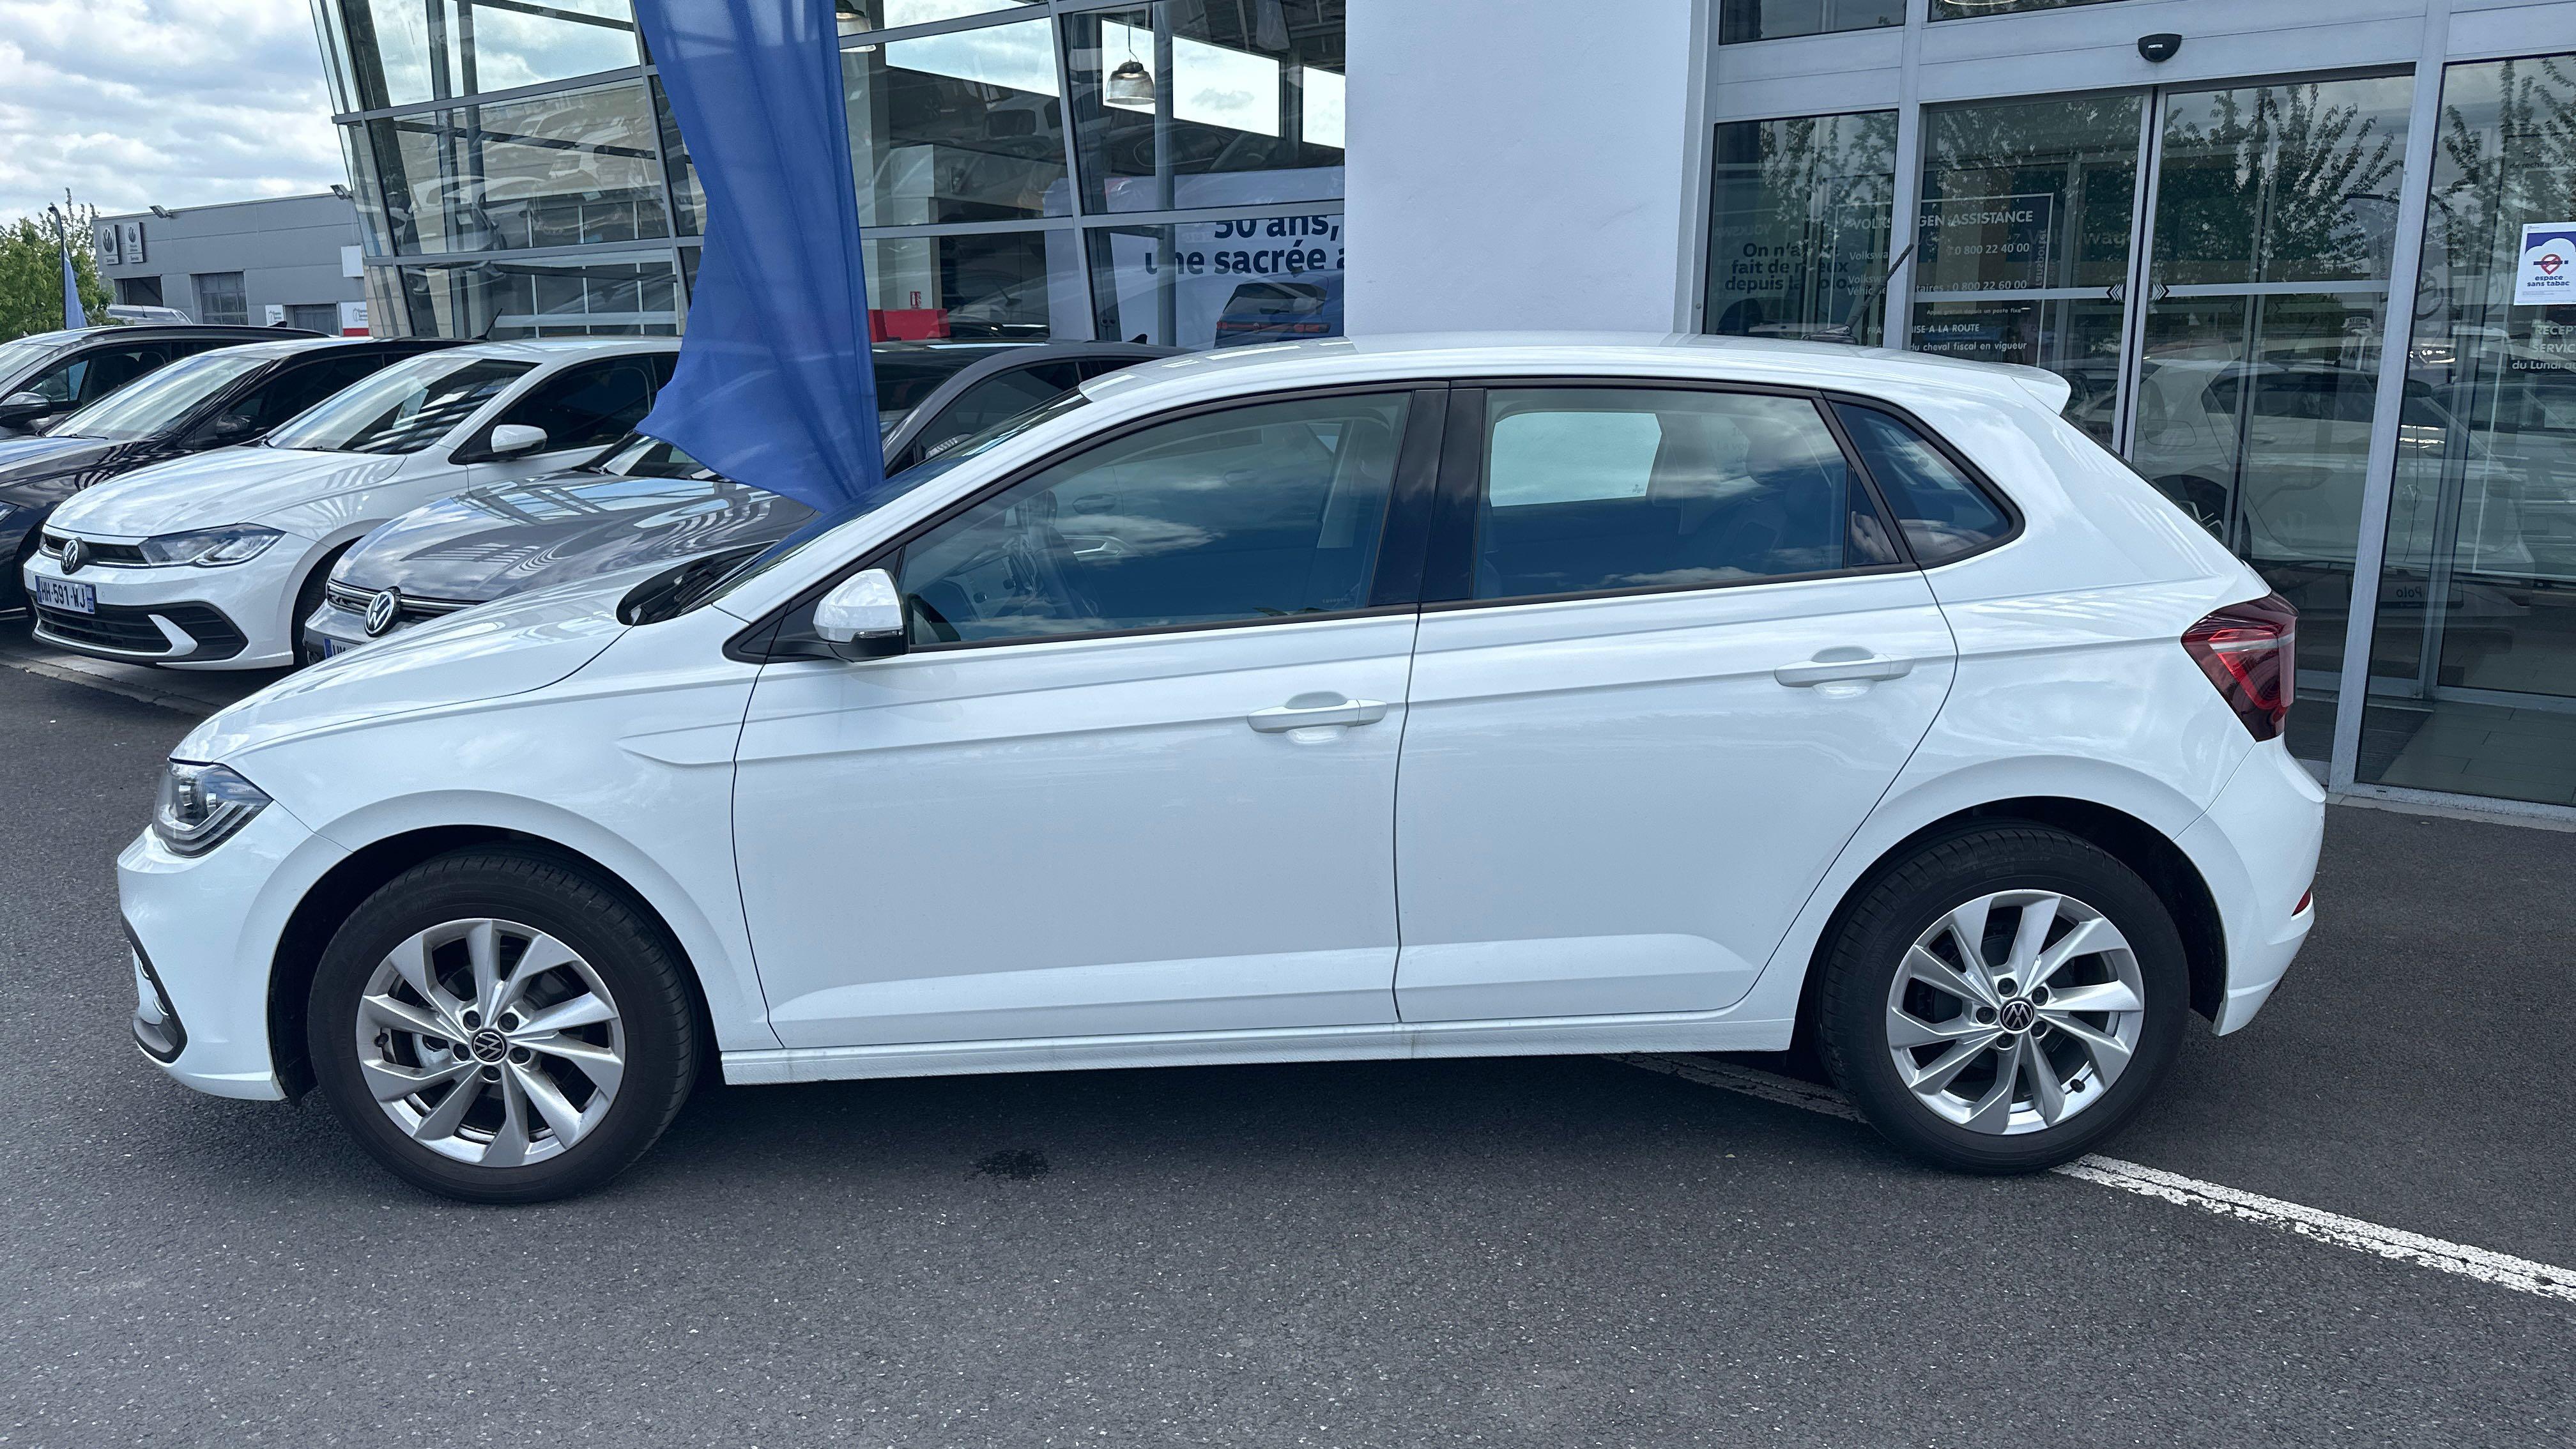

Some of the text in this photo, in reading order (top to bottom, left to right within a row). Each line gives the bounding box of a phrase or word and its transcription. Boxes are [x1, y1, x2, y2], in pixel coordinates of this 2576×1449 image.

[1951, 210, 2034, 226] ASSISTANCE
[1266, 215, 1339, 241] ans,
[1743, 243, 1768, 257] On
[1850, 250, 1889, 261] Volkswa
[1954, 243, 2030, 255] 0 800 22 40 00
[1145, 251, 1205, 275] une
[1214, 240, 1326, 275] sacrée
[1732, 259, 1763, 273] fait
[1768, 259, 1790, 273] de
[1725, 275, 1784, 293] depuis
[1848, 273, 1886, 285] Volksw
[1847, 285, 1887, 296] Véhice
[1916, 284, 1943, 293] taires
[1952, 282, 1959, 291] 0
[1961, 282, 1980, 291] 800
[1982, 281, 1995, 290] 22
[1998, 280, 2011, 289] 60
[2014, 280, 2027, 289] 00
[1867, 325, 1883, 335] FRA
[1912, 325, 1926, 334] ISE
[1938, 325, 1949, 333] LA
[1952, 323, 1980, 332] ROUTE
[1923, 342, 1949, 351] cheval
[1954, 341, 1976, 351] fiscal
[1980, 342, 1991, 351] en
[1995, 341, 2027, 352] vigueur
[2531, 343, 2576, 353] SERVIC
[2512, 360, 2527, 369] du
[2530, 360, 2561, 369] Lundi
